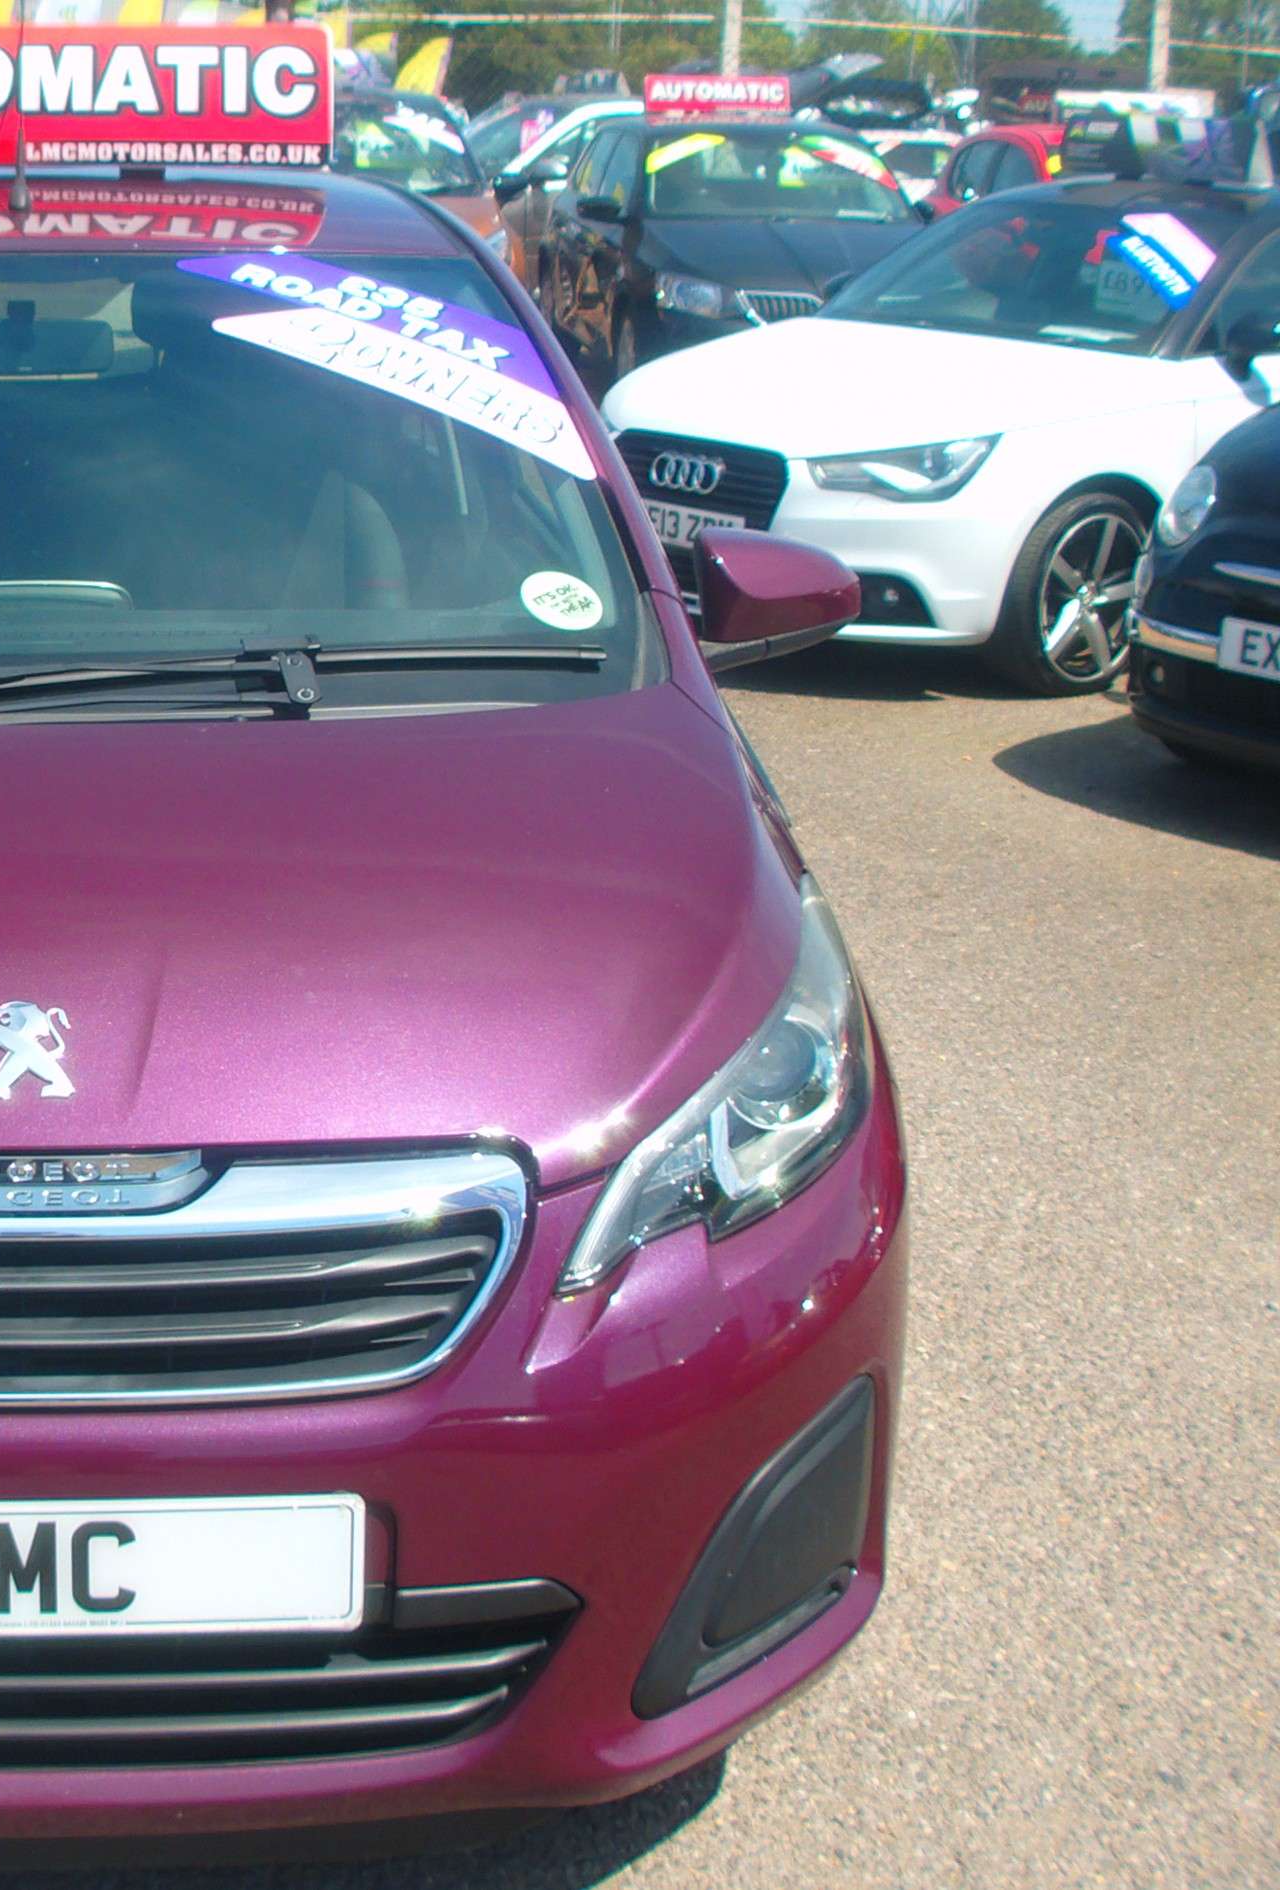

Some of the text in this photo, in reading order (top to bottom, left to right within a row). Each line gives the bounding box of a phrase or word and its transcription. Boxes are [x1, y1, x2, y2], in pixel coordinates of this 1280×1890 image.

[650, 80, 785, 104] AUTOMATIC
[25, 141, 322, 165] LMCMOTORSALES.CO.UK
[230, 263, 515, 371] ROAD TAX
[345, 338, 566, 444] OWNERS
